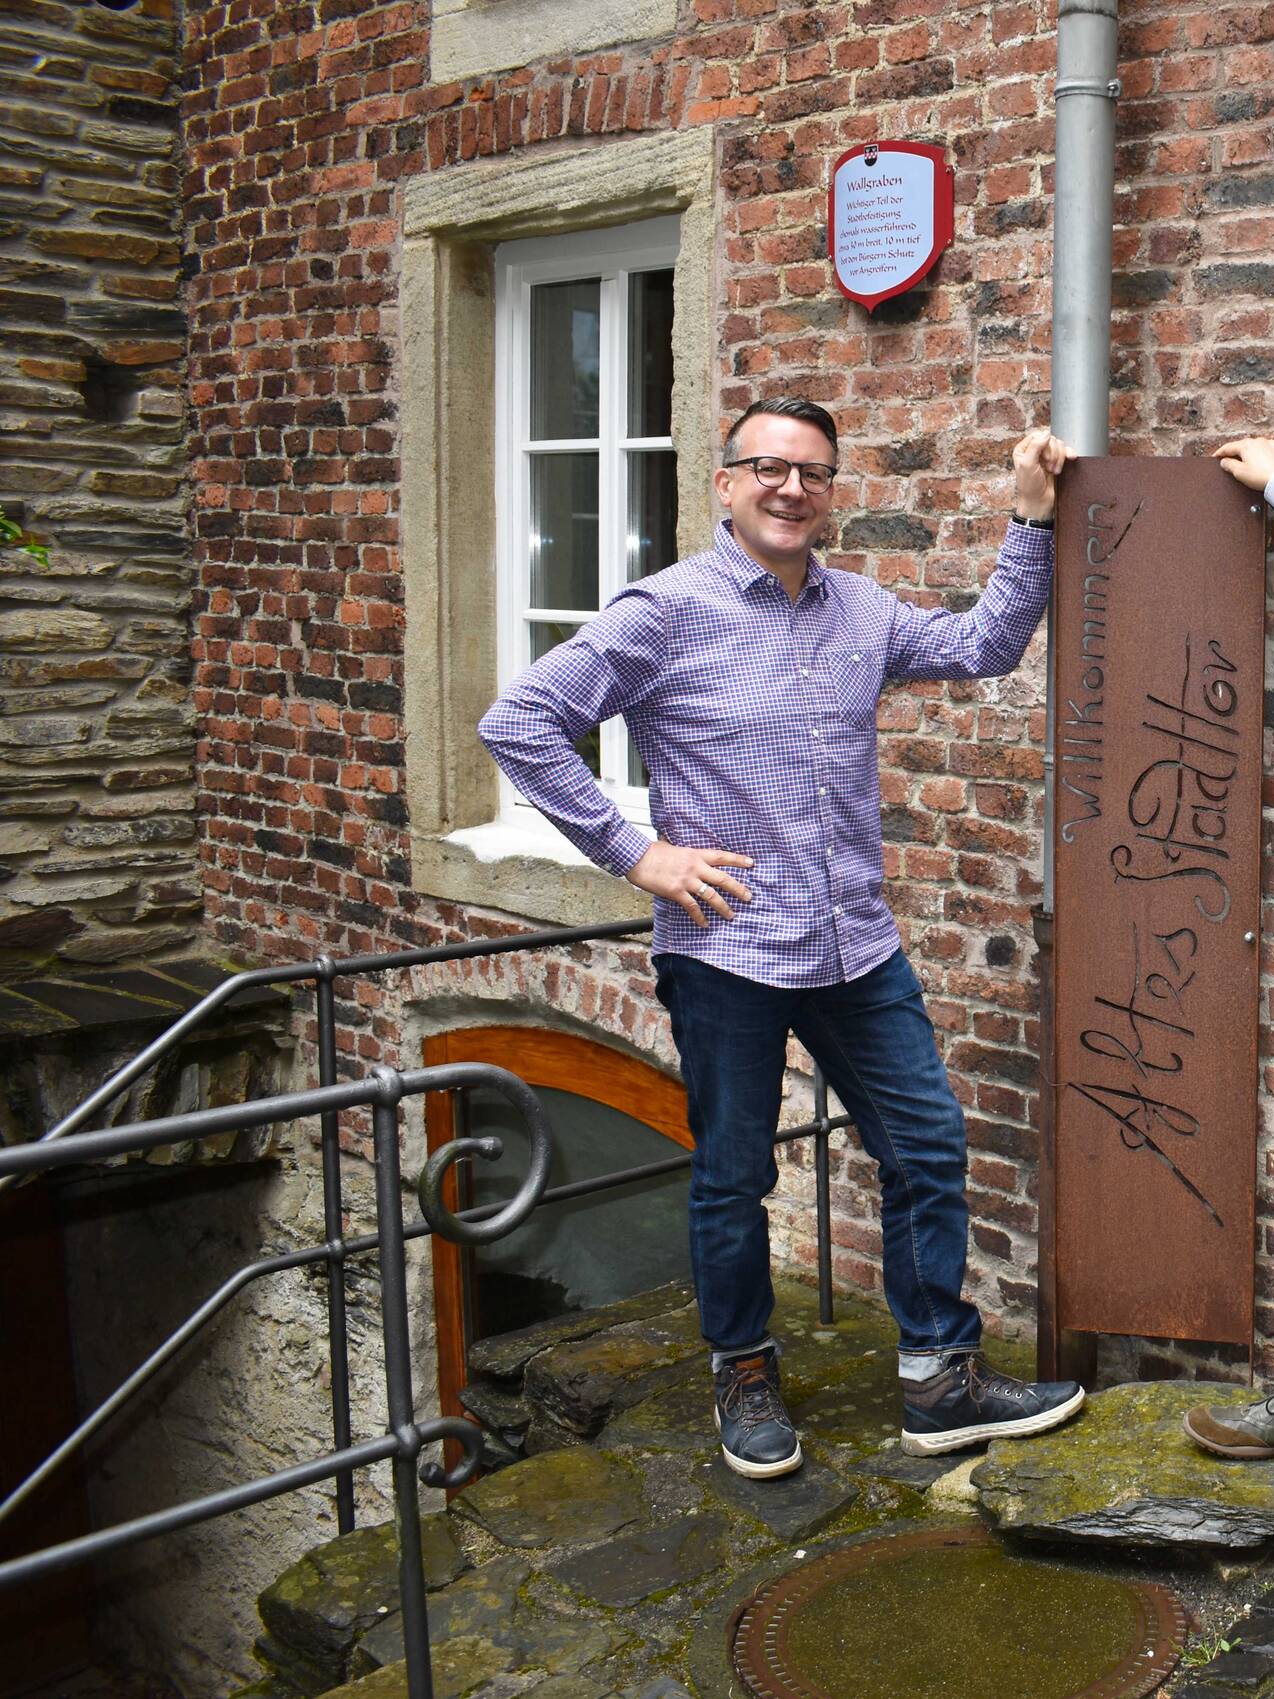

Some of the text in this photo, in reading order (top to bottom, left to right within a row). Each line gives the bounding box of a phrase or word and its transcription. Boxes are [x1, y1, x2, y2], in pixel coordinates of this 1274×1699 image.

[847, 174, 902, 192] Wallgraben
[877, 195, 889, 205] Teil
[890, 196, 904, 204] der
[860, 222, 917, 234] wasserführend
[907, 233, 922, 244] tief
[888, 249, 915, 259] Schutz
[859, 263, 897, 276] Angreifern
[1069, 921, 1224, 1228] Altes
